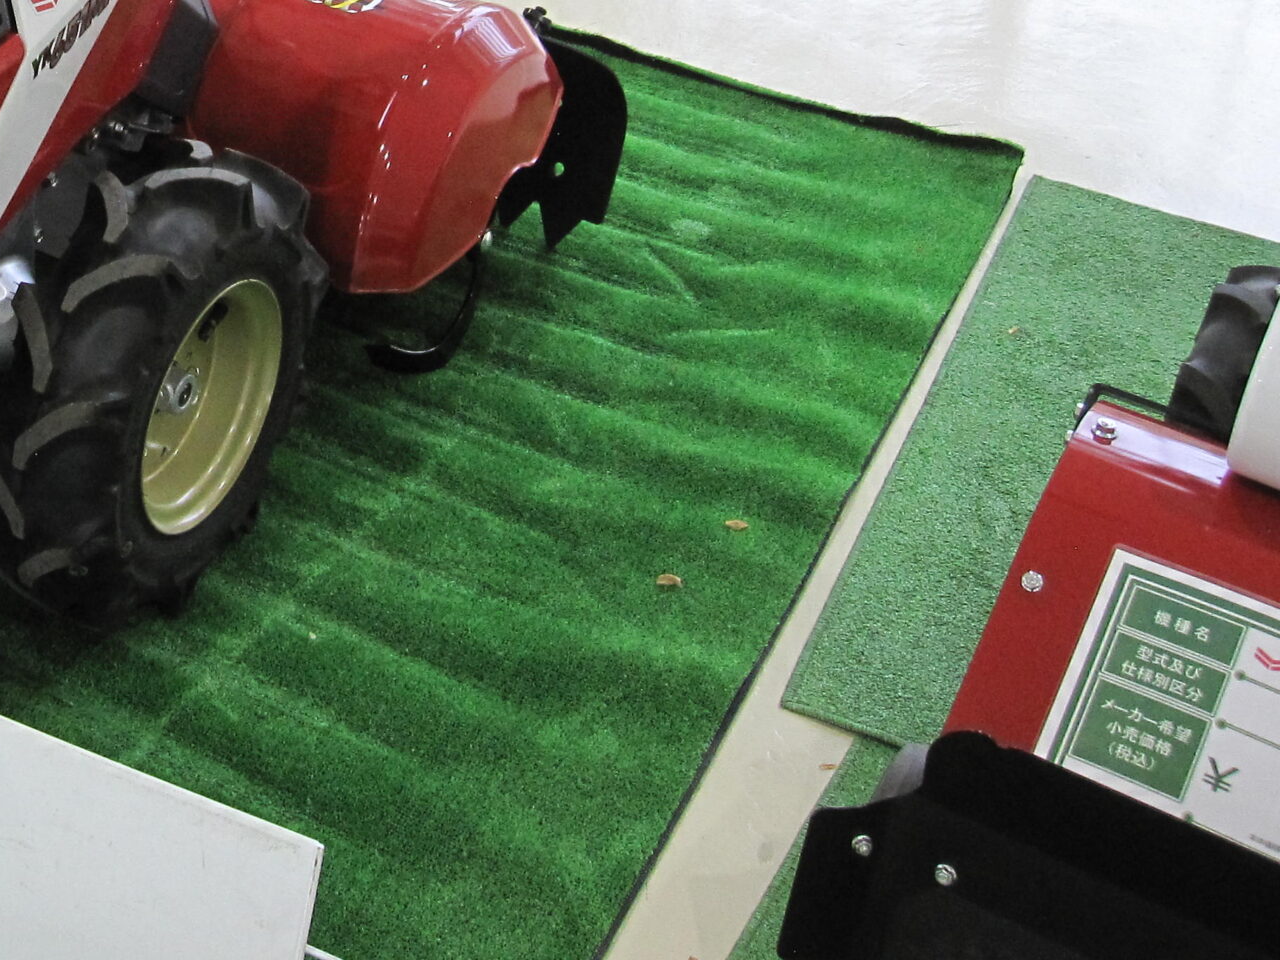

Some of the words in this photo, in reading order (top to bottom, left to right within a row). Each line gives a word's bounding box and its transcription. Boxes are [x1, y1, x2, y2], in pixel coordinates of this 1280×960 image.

[1153, 609, 1211, 642] 機種名
[1135, 644, 1204, 680] 型式及び
[1121, 659, 1204, 703] 仕様別区分
[1100, 698, 1193, 744] メーカー希望
[1106, 720, 1172, 757] 小売価格
[1202, 755, 1240, 793] ¥
